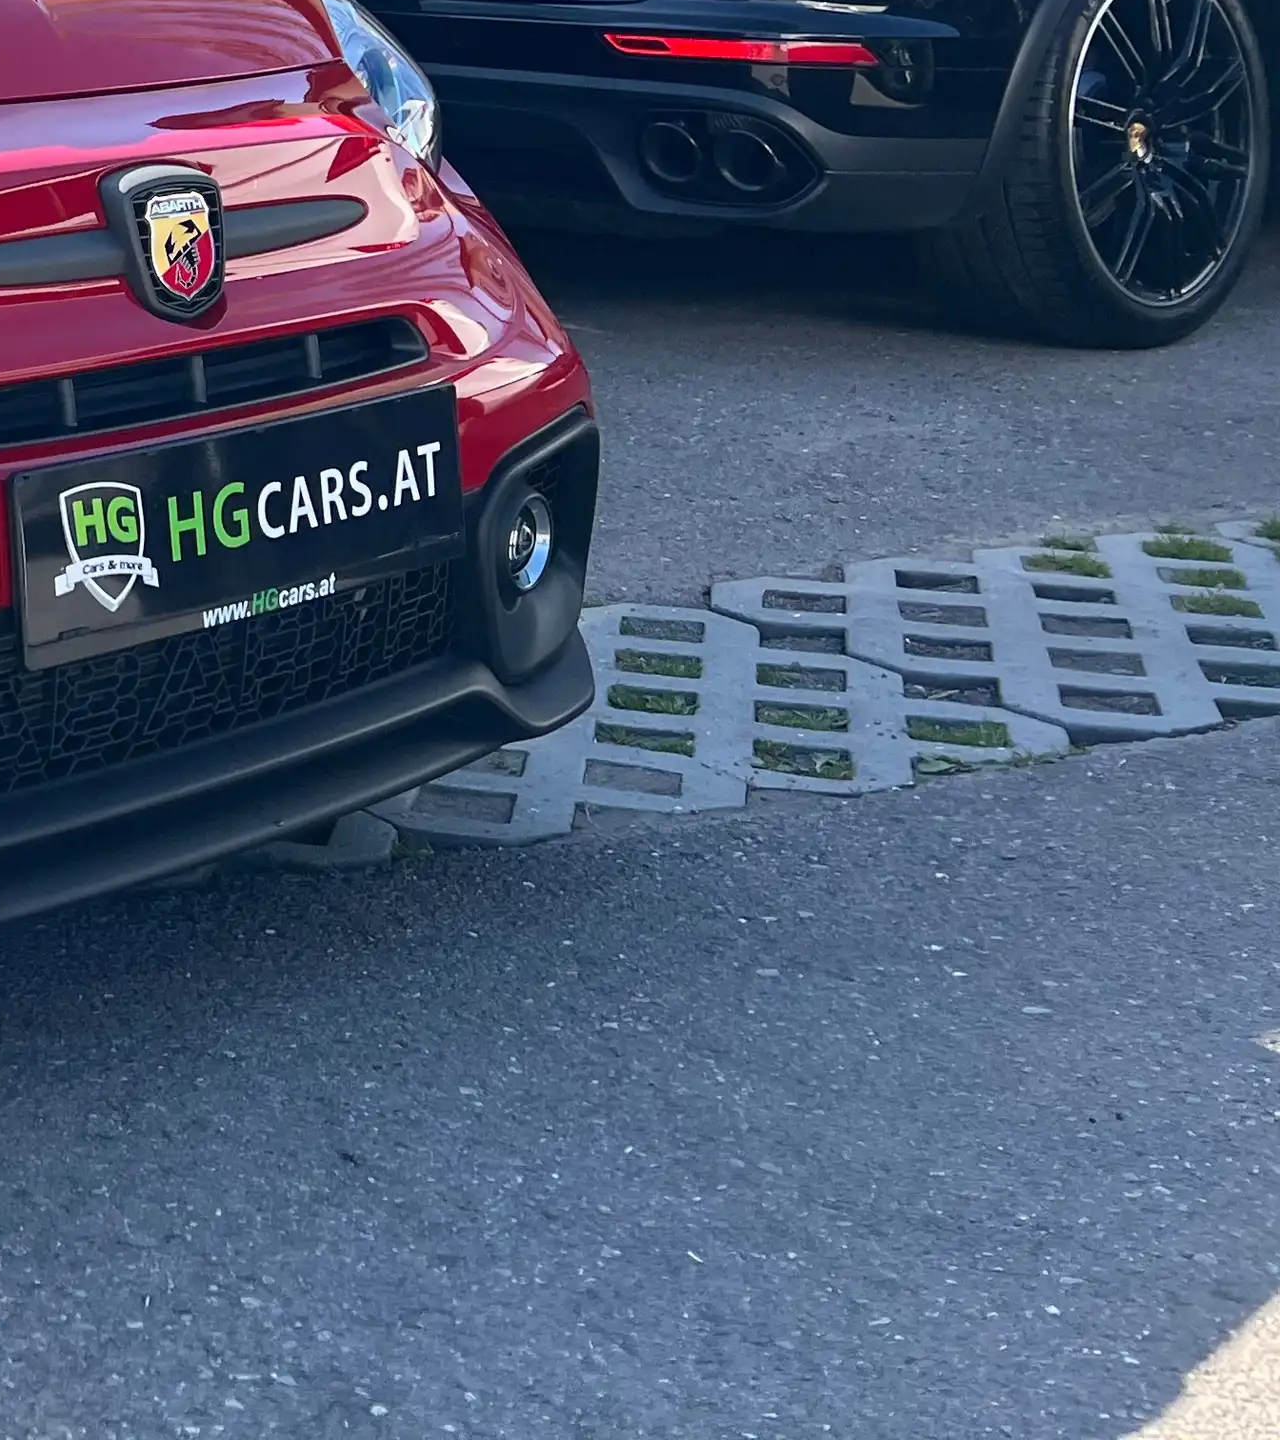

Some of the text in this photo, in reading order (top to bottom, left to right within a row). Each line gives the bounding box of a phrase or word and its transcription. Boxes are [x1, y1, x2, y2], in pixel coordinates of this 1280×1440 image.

[151, 198, 202, 213] ABARTH
[73, 496, 137, 547] HG
[168, 441, 441, 563] HGCARS.AT
[82, 559, 144, 574] Cars & more
[202, 572, 337, 629] www.HGcars.at
